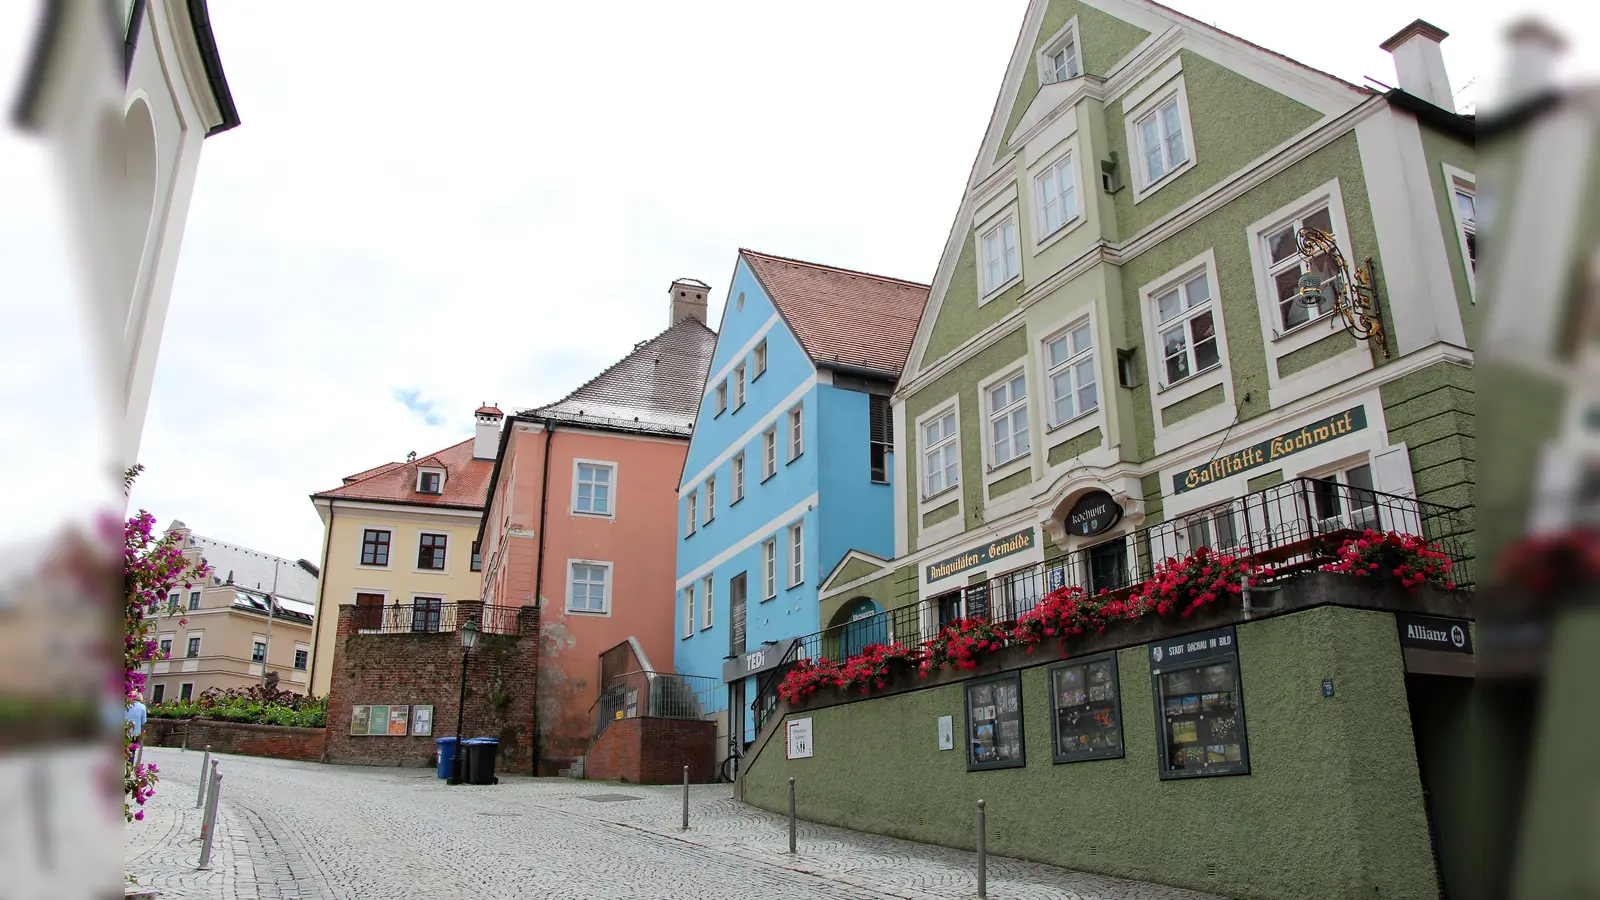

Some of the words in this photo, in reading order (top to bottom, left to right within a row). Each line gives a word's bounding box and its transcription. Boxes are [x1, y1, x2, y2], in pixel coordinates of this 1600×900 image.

[1269, 411, 1353, 462] Kochwirt
[930, 553, 979, 580] Antiquitäten
[988, 533, 1030, 559] Gemälde
[1407, 624, 1448, 642] Allianz
[1168, 645, 1184, 656] STADT
[1187, 639, 1207, 653] DACHAU
[1209, 638, 1217, 648] IM
[1218, 635, 1232, 647] BILD
[746, 649, 765, 671] TEDi
